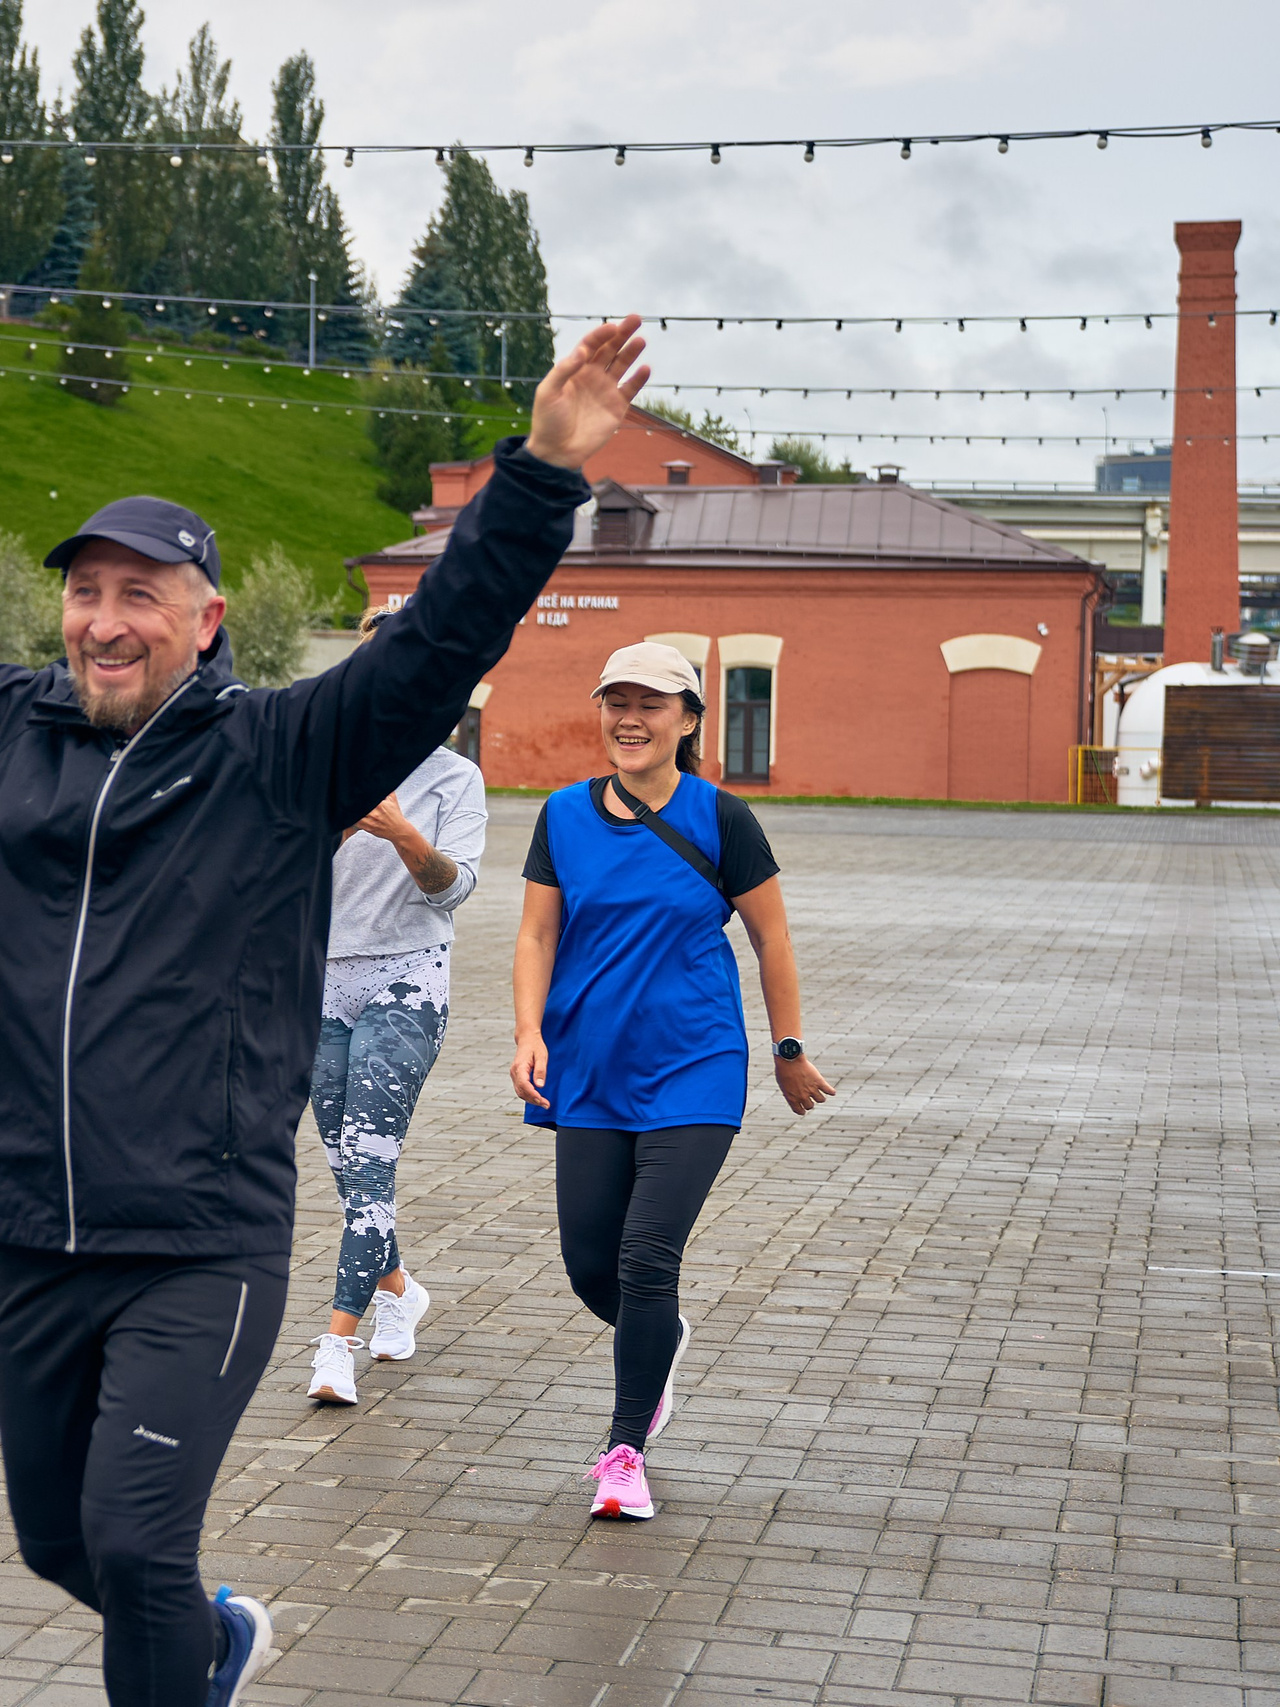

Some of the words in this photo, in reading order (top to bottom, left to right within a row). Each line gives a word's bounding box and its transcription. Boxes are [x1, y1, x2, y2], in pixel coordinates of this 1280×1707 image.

[537, 592, 559, 609] ВСЁ
[560, 595, 575, 609] НА
[577, 595, 619, 609] КРАНАХ
[536, 611, 545, 625] И
[546, 611, 569, 627] ЕДА
